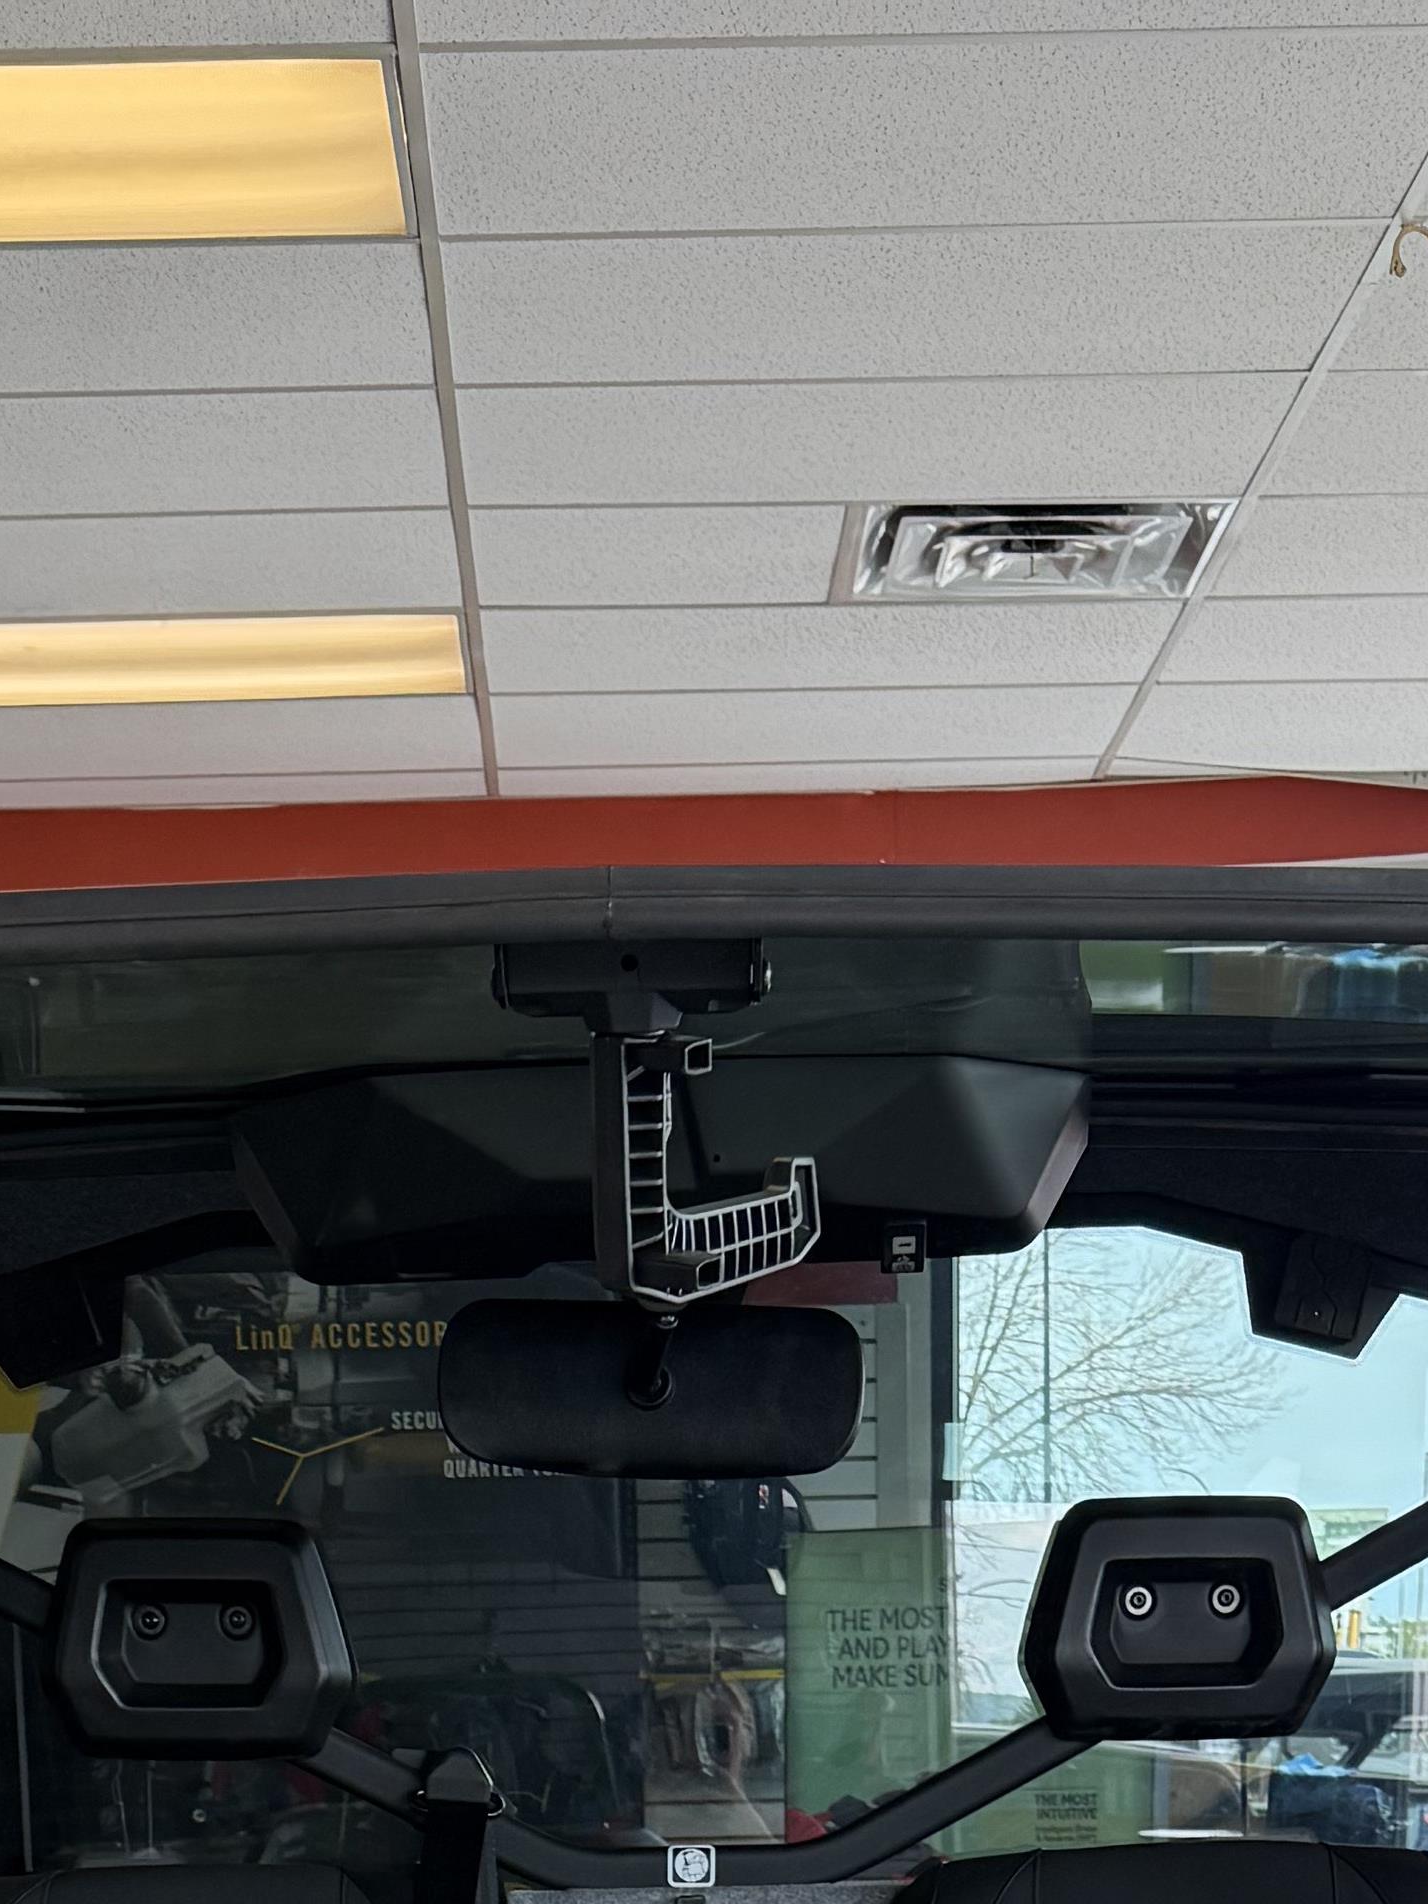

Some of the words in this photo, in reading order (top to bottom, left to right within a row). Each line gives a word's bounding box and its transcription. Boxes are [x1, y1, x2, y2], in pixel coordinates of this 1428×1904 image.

[826, 1610, 872, 1632] THE
[879, 1606, 949, 1631] MOST
[838, 1637, 890, 1660] AND
[832, 1666, 898, 1689] MAKE
